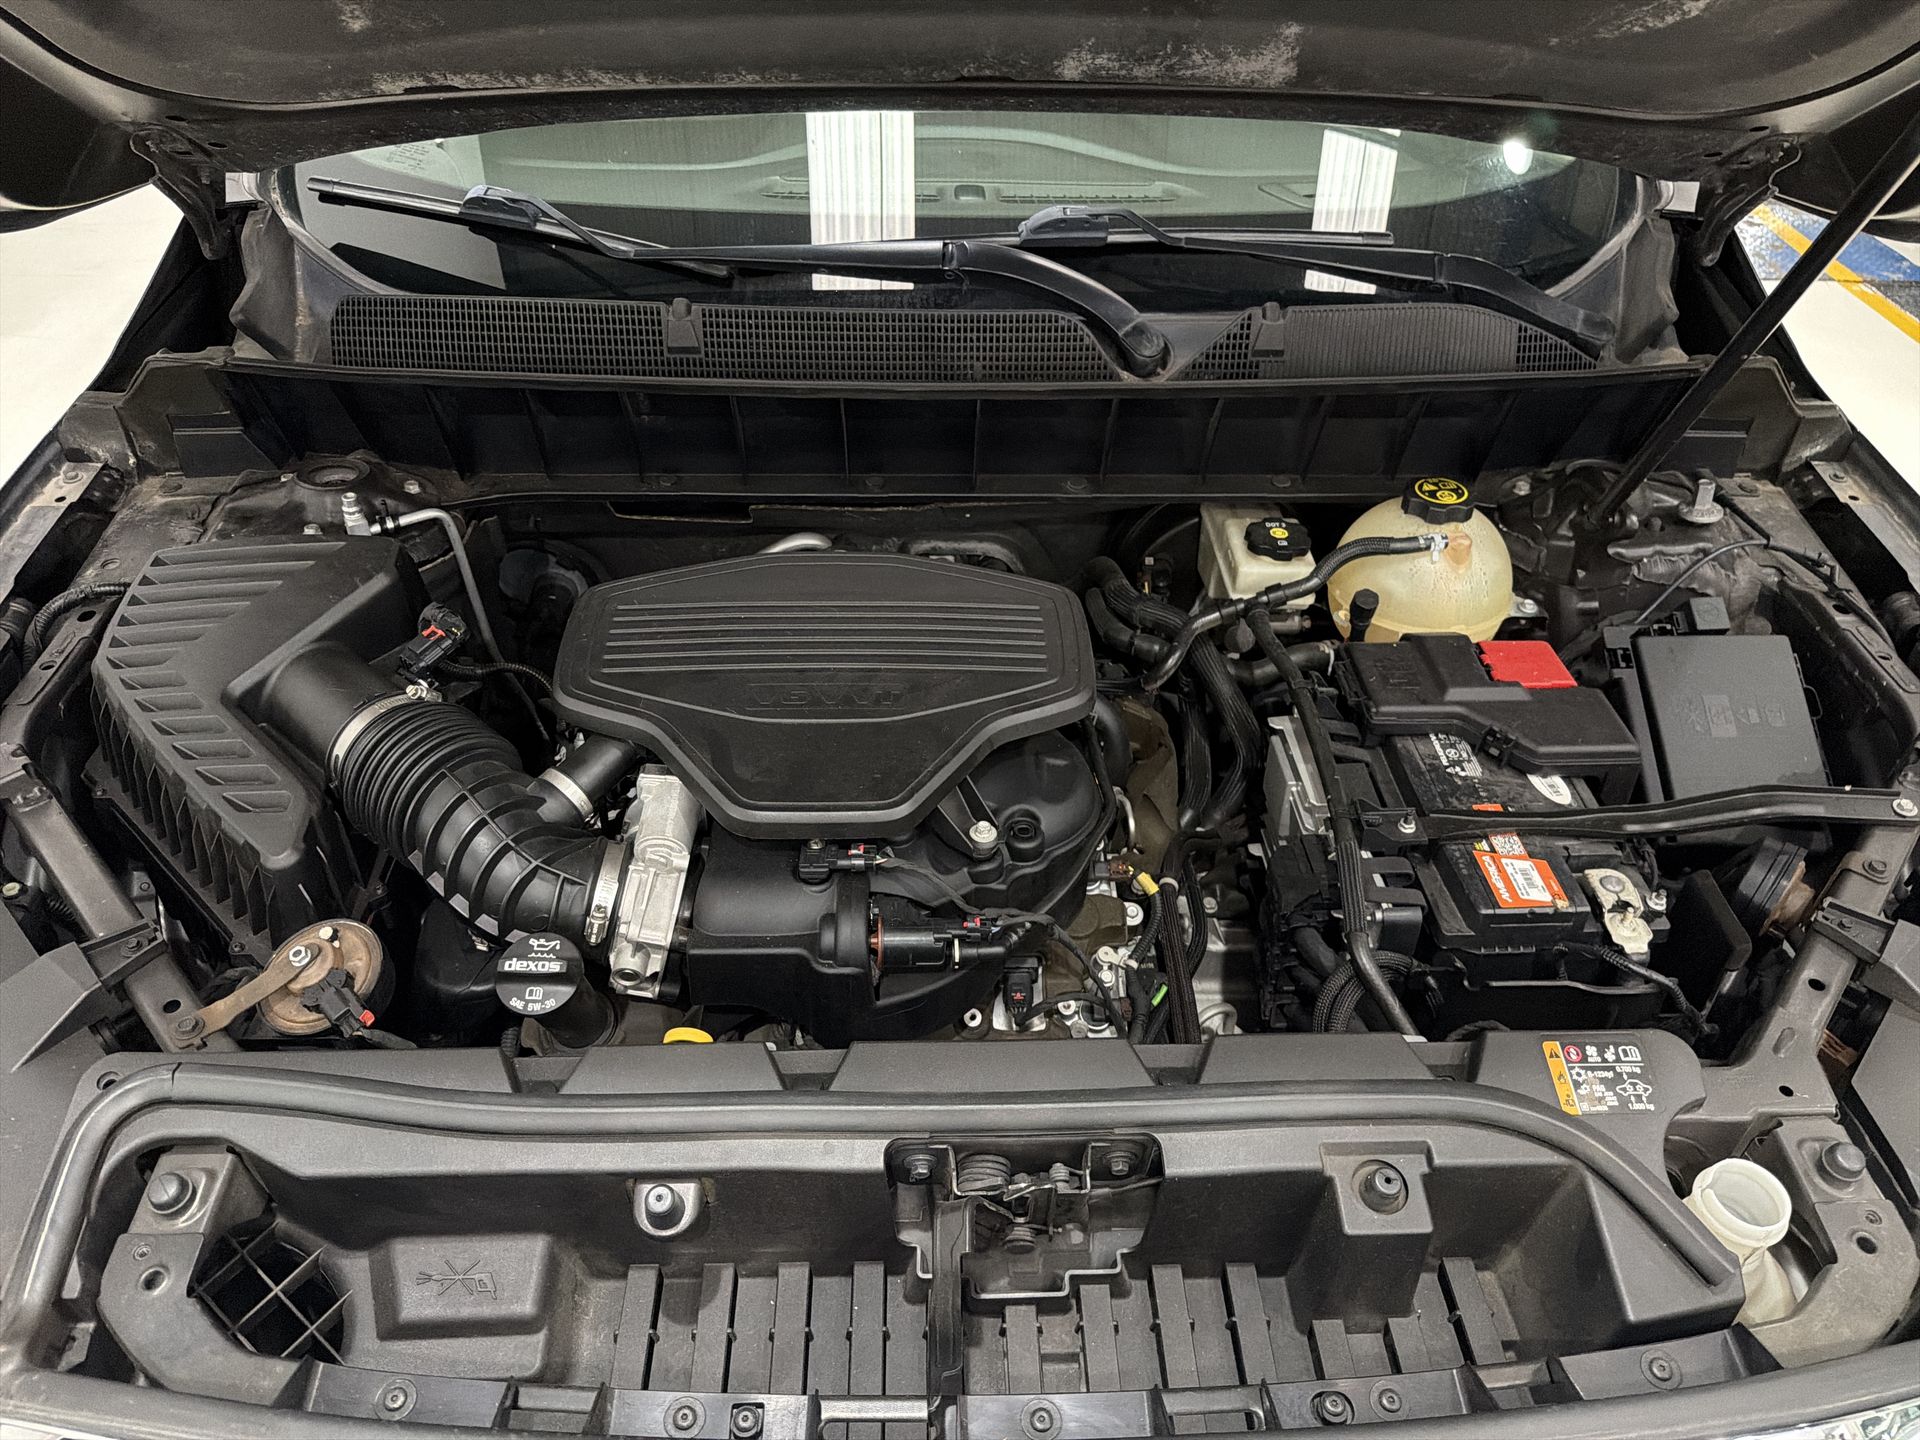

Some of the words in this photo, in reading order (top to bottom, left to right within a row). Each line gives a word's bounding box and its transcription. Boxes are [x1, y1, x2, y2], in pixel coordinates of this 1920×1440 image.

[504, 957, 563, 972] dexos
[509, 997, 526, 1010] SAE
[527, 998, 556, 1011] 5W-30
